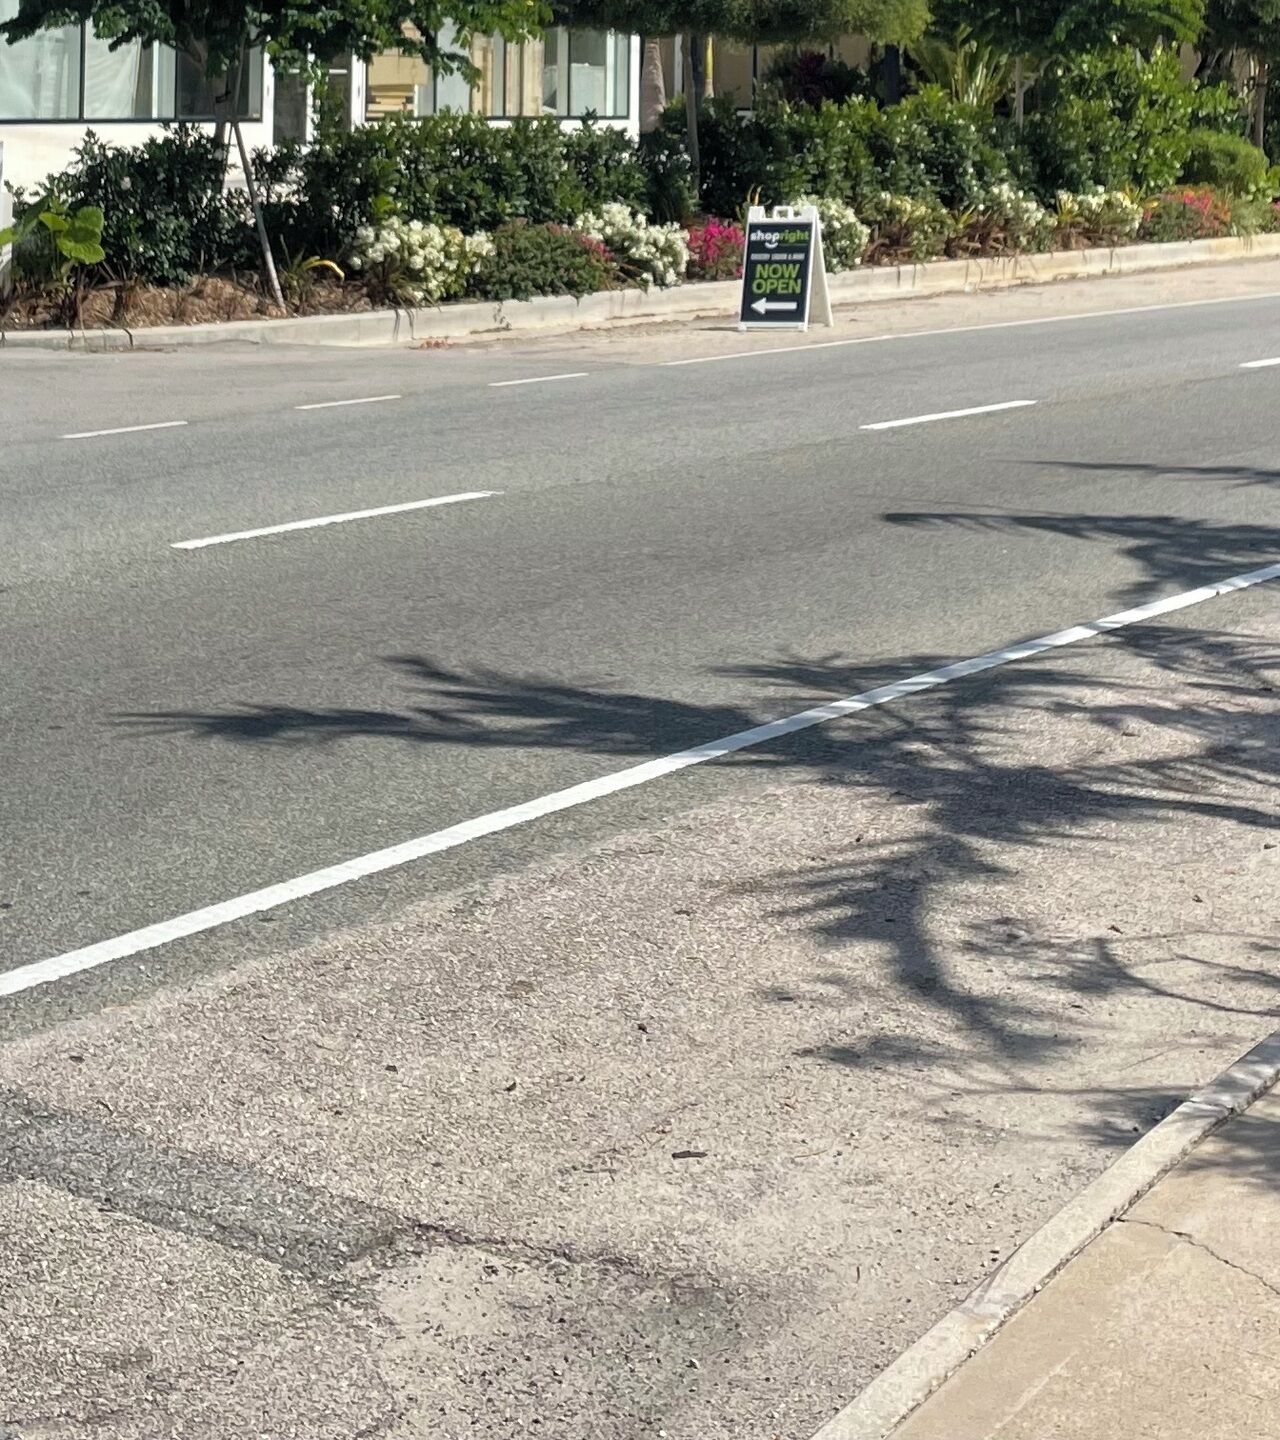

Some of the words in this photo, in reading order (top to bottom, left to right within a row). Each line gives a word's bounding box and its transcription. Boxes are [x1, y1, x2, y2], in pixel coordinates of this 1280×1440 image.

[750, 229, 809, 243] shopright
[755, 263, 800, 279] NOW
[752, 278, 801, 294] OPEN
